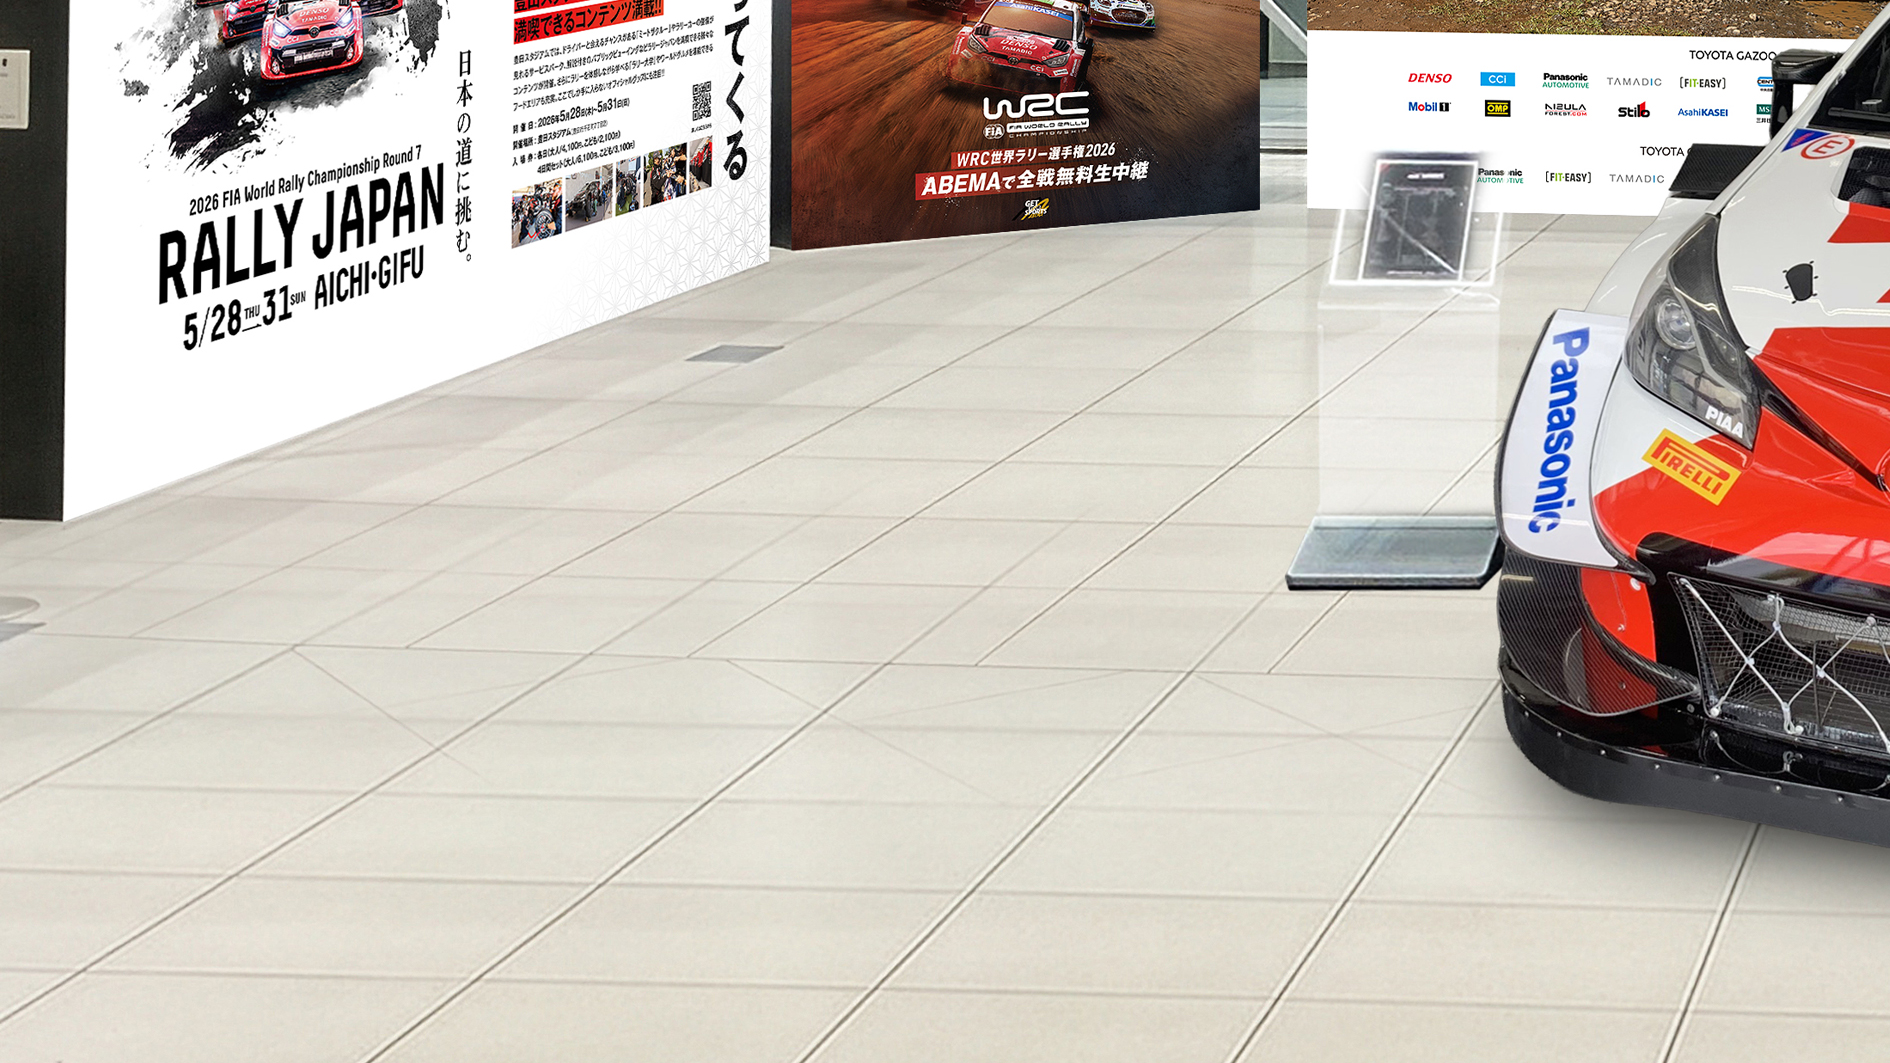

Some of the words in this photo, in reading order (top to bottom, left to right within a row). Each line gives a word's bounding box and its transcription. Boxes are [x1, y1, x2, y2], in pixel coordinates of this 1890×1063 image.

[1688, 50, 1734, 60] TOYOTA
[1408, 73, 1452, 83] DENSO
[1543, 73, 1589, 82] Panasonic
[1542, 81, 1590, 89] AUTOMOTIVE
[1606, 77, 1662, 87] TAMADIC
[983, 91, 1090, 120] WRC
[1408, 101, 1438, 112] Mobil
[1487, 104, 1509, 113] OMP
[1677, 107, 1729, 117] AsahiKASEI
[455, 49, 474, 262] 日本の道に挑む。
[957, 142, 1116, 168] WRC世界ラリー選手権2026
[1640, 145, 1685, 157] TOYOTA
[189, 193, 219, 216] 2026
[222, 188, 241, 209] FIA
[244, 181, 275, 203] World
[278, 174, 305, 197] Rally
[307, 156, 380, 187] Championship
[382, 148, 412, 171] Round
[415, 144, 422, 161] 7
[921, 161, 1150, 196] ABEMAで全戦無料生中継
[1609, 174, 1665, 184] TAMADIC
[159, 198, 305, 304] RALLY
[312, 162, 445, 260] JAPAN
[183, 298, 242, 351] 5/28
[244, 304, 261, 320] THU
[262, 284, 292, 326] 31
[290, 289, 307, 305] SUN
[1527, 326, 1590, 534] Panasonic
[1704, 404, 1744, 439] PIAA
[1650, 435, 1735, 499] PIRELLI
